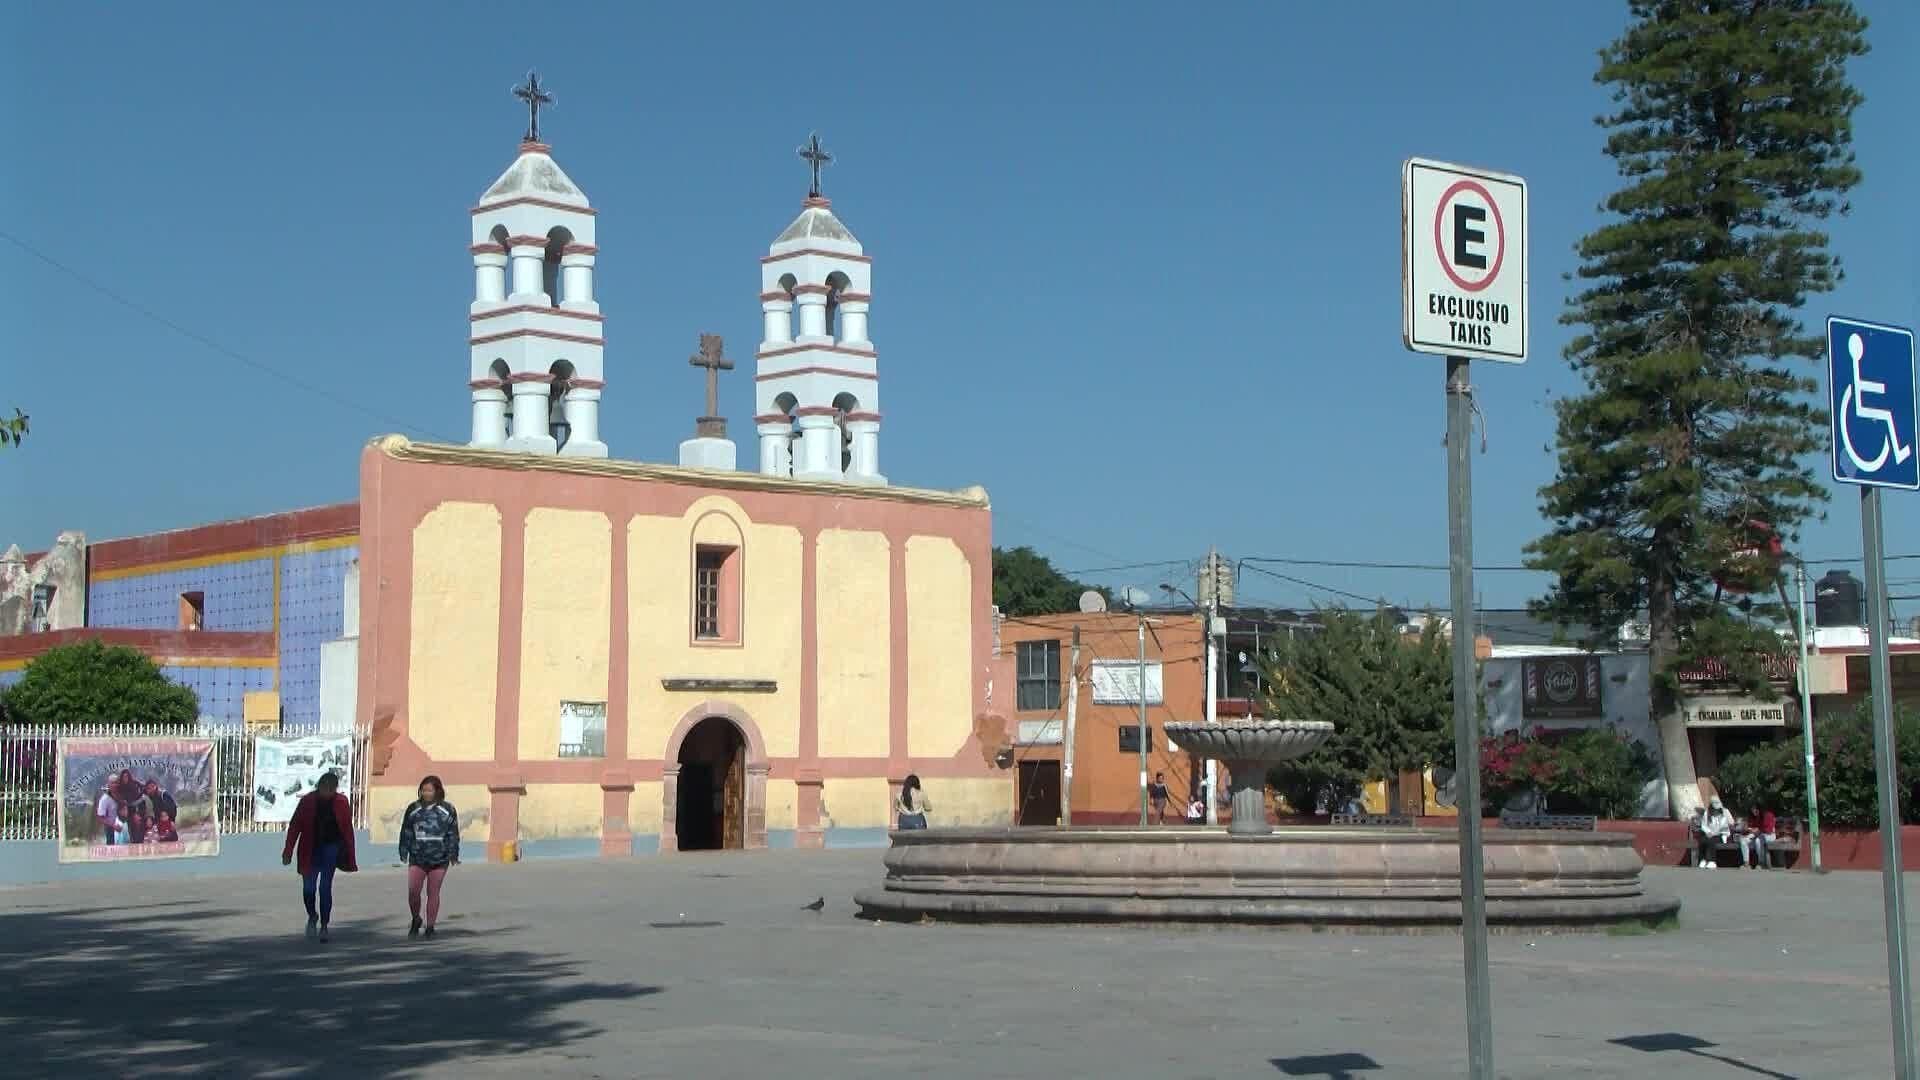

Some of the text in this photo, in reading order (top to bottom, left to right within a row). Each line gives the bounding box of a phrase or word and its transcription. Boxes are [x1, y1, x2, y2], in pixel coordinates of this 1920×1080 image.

[1454, 204, 1487, 270] E
[1429, 293, 1509, 324] EXCLUSIVO
[1449, 321, 1491, 346] TAXIS
